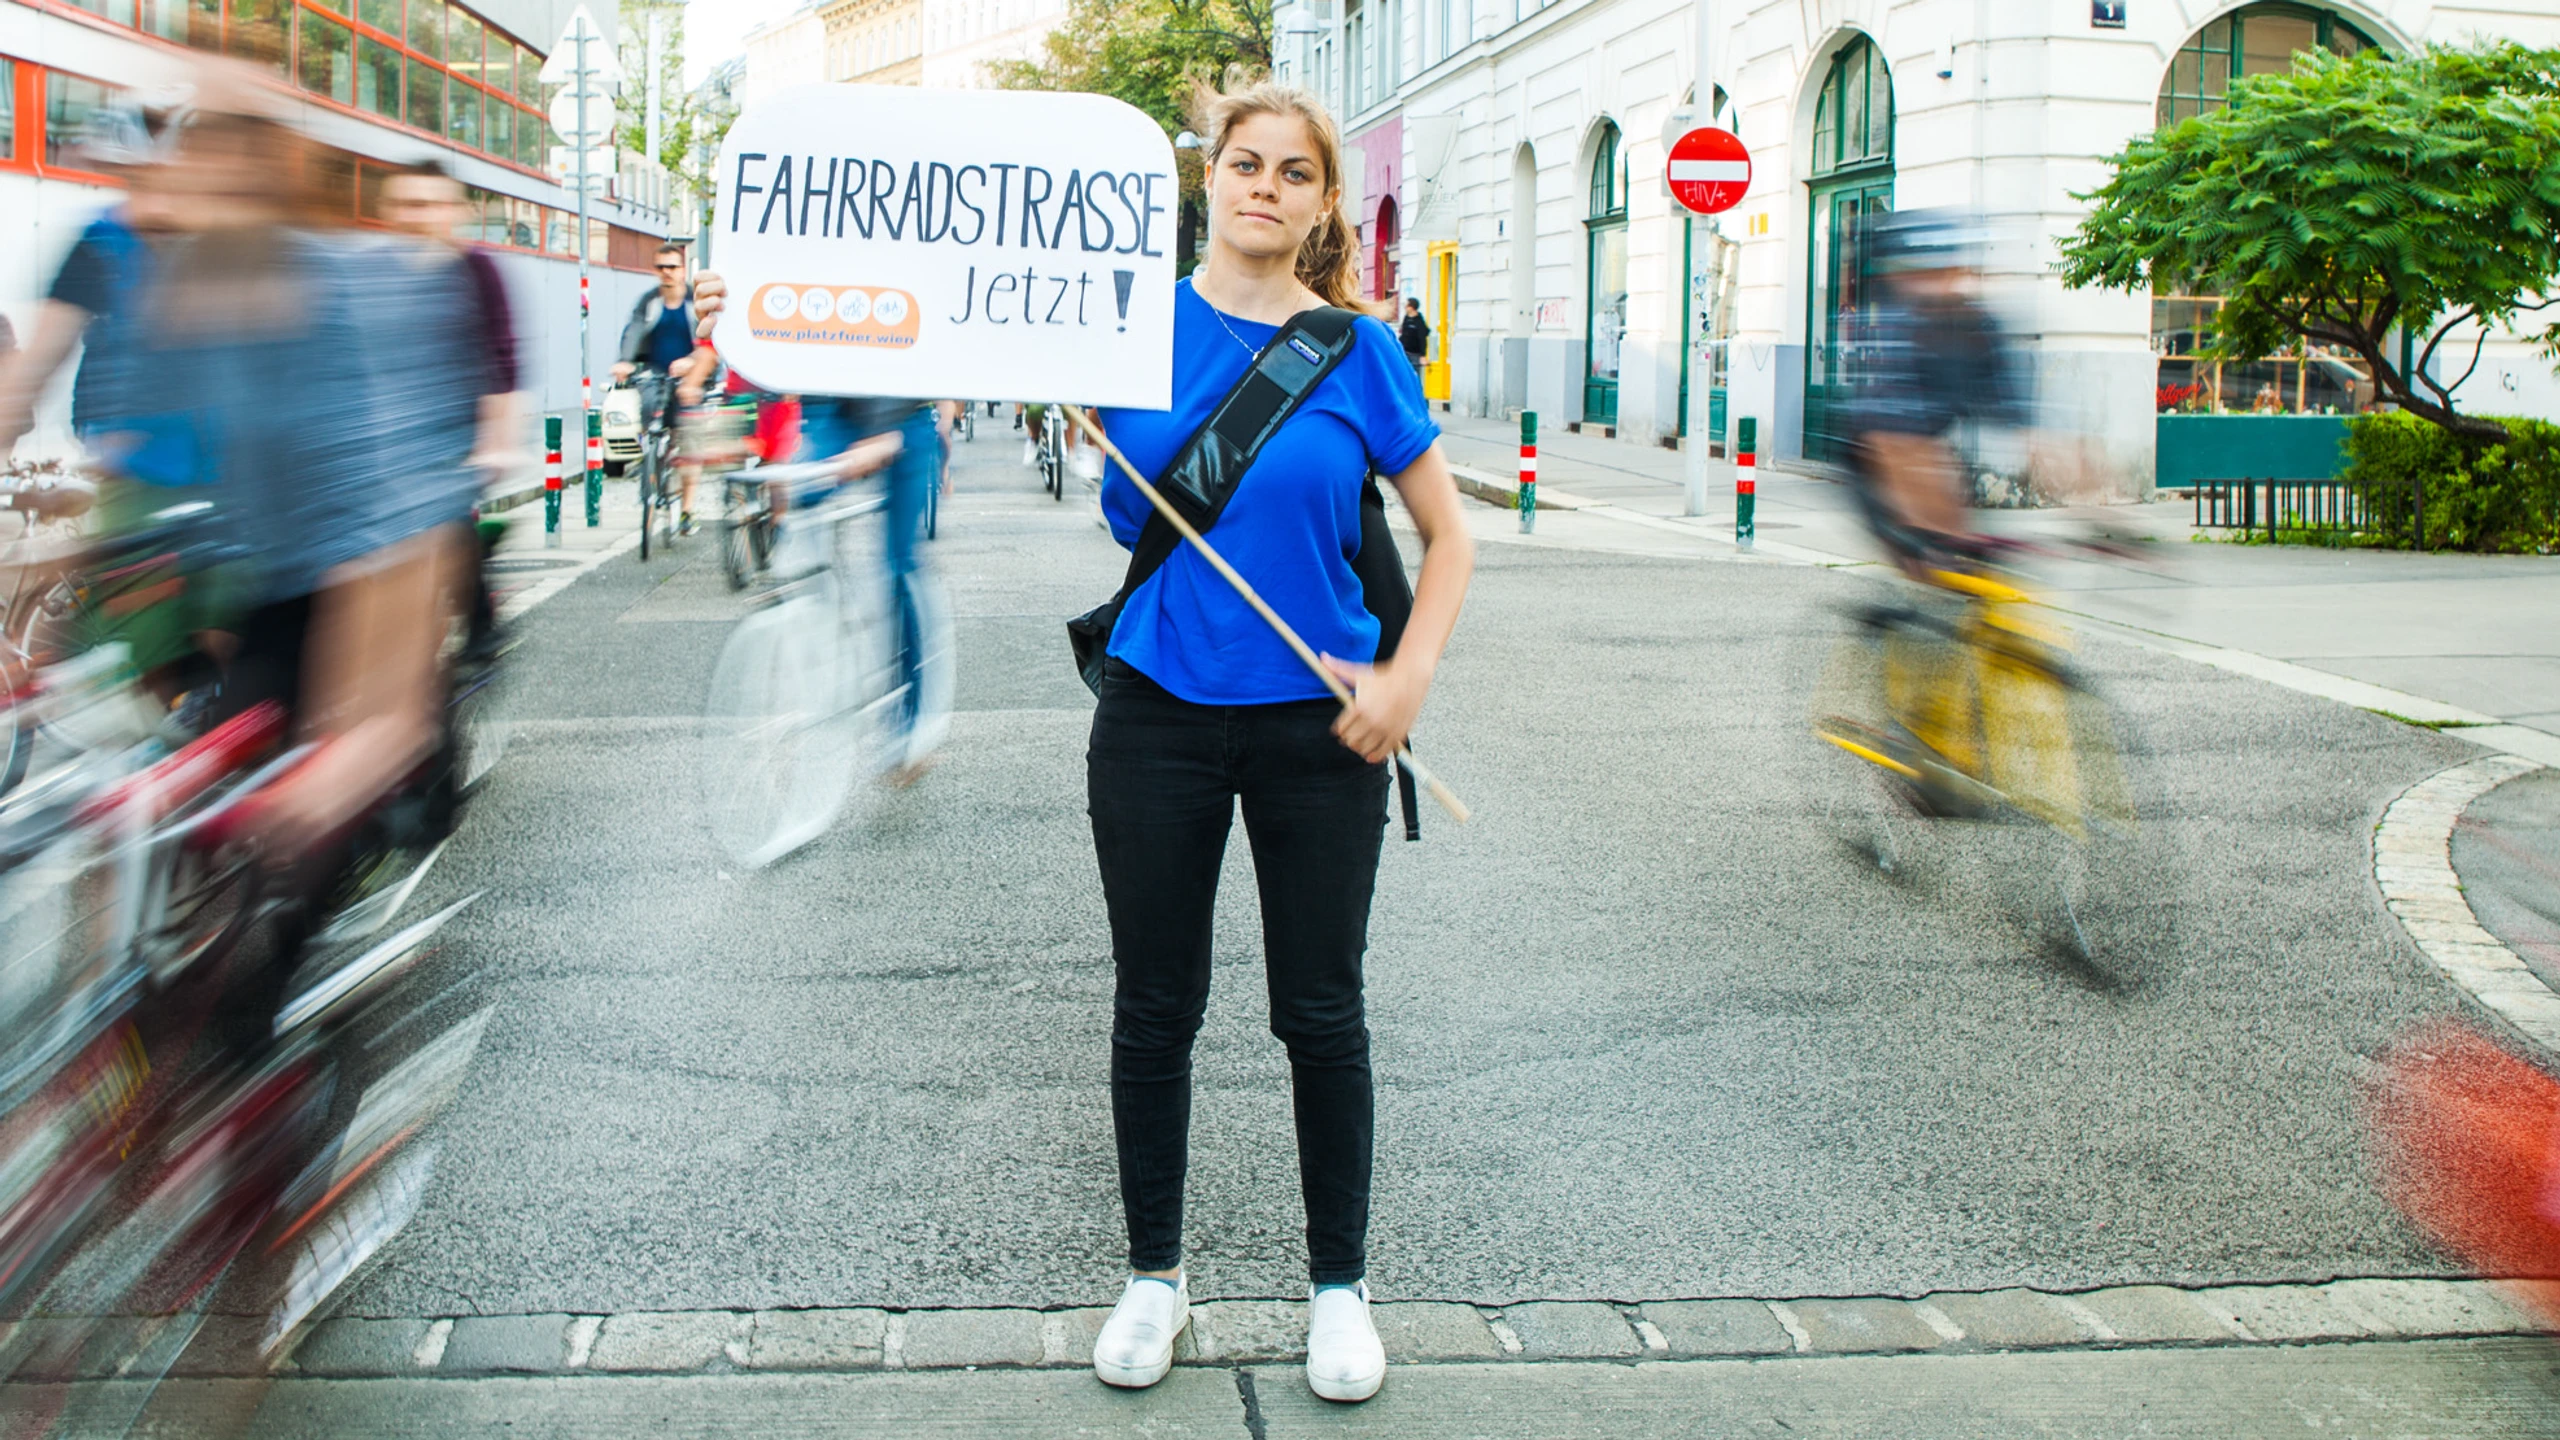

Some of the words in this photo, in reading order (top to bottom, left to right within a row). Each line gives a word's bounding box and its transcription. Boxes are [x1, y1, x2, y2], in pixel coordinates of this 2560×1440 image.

[2104, 3, 2115, 19] 1
[731, 152, 1168, 258] FAHRRADSTRASSE
[1684, 181, 1727, 207] HIV+
[751, 327, 915, 345] www.platzfuer.wien
